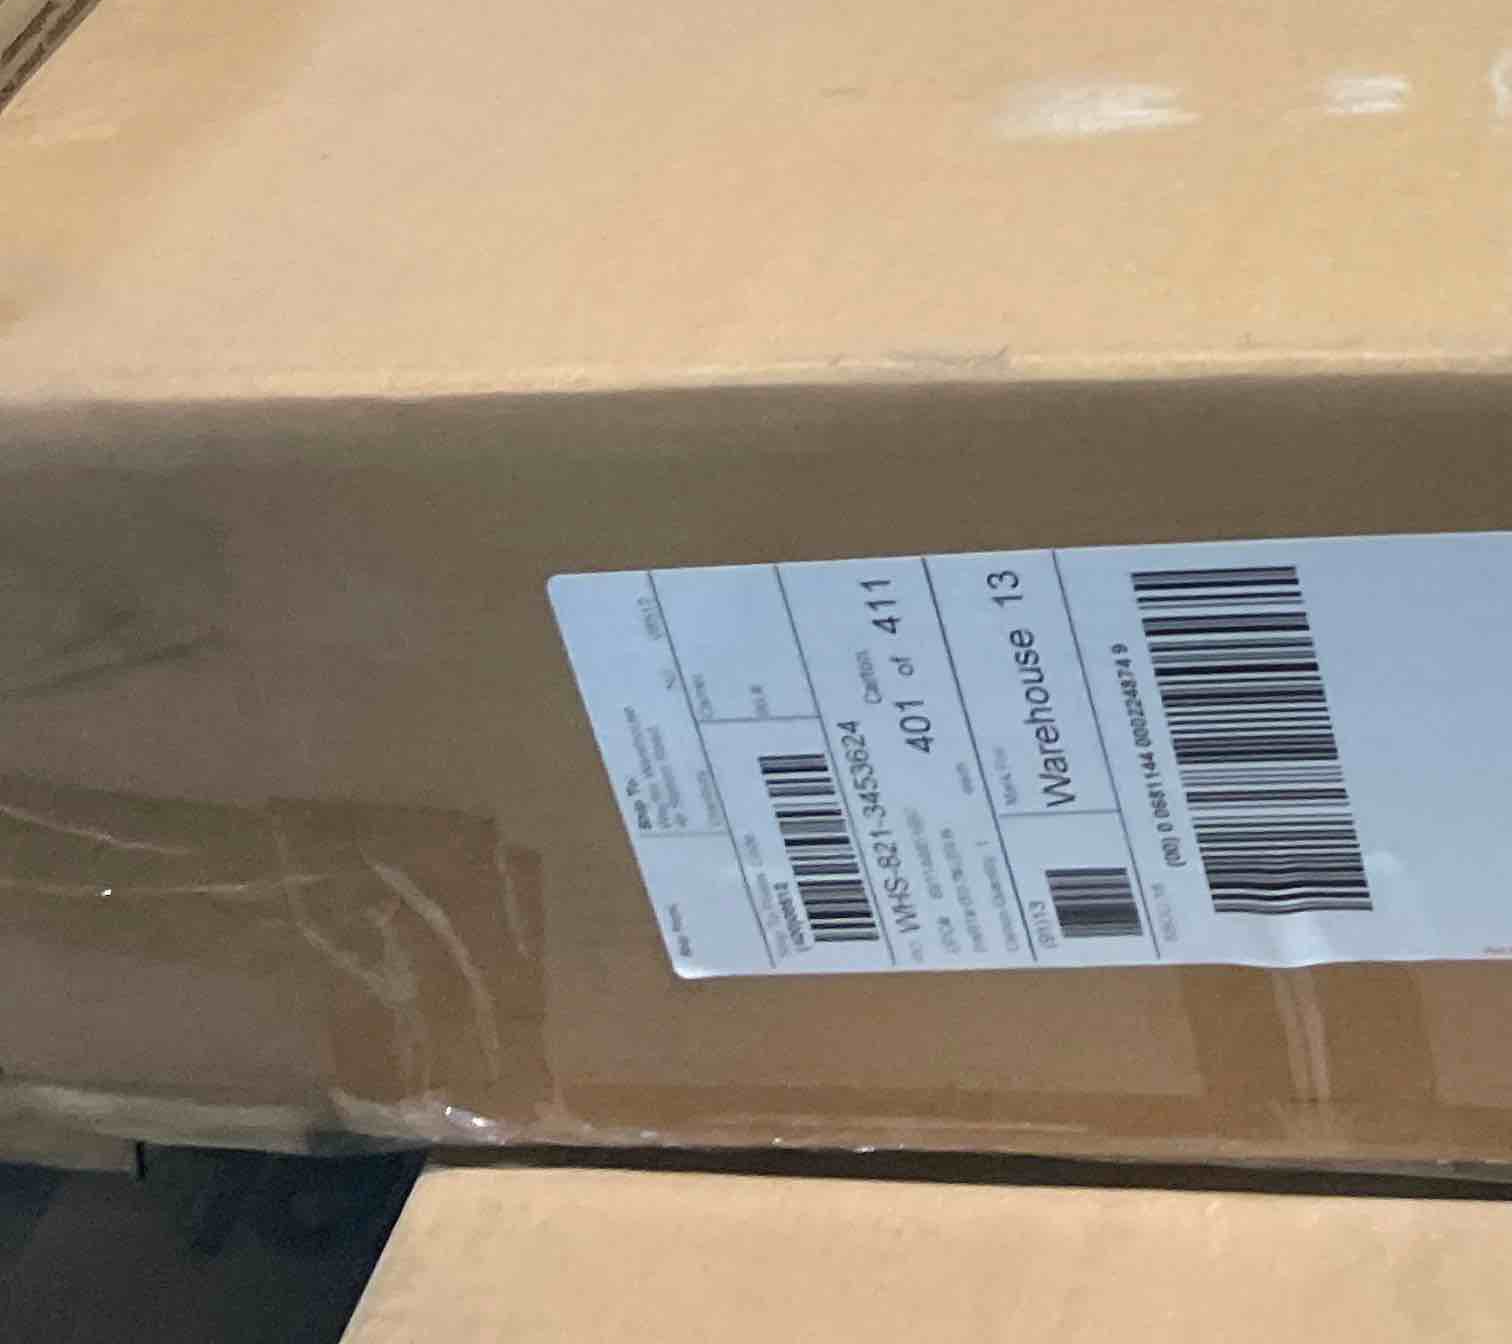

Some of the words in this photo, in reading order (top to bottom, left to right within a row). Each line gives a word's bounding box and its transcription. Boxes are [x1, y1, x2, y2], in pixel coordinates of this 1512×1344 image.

[859, 578, 899, 634] 411
[986, 570, 1023, 608] 13
[854, 650, 884, 704] Carton
[893, 656, 915, 677] of
[896, 699, 932, 753] 401
[1008, 629, 1072, 807] Warehouse
[838, 721, 920, 933] WHS-821-3453624
